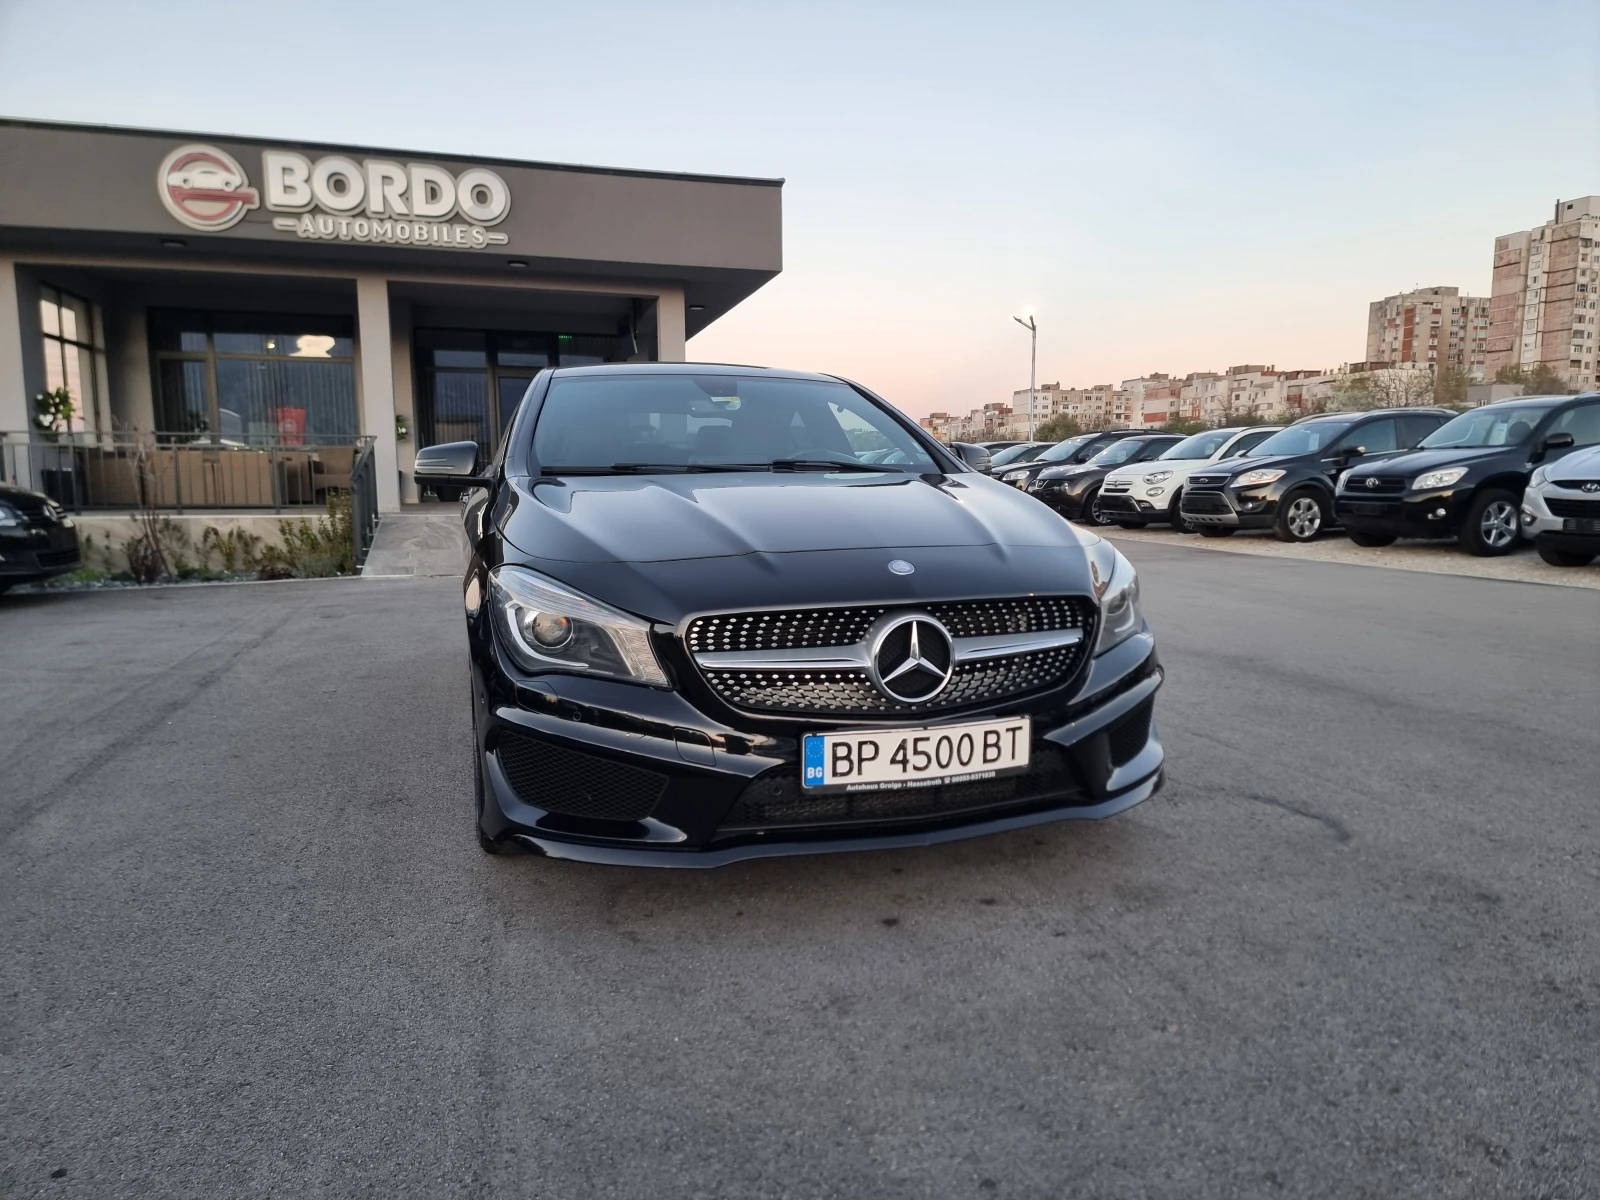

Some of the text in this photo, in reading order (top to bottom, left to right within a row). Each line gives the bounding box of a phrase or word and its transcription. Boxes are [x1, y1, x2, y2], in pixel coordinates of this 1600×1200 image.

[265, 152, 509, 222] BORDO
[299, 220, 485, 246] AUTOMOBILES
[831, 725, 1024, 778] BP 4500 BT
[807, 767, 823, 778] BG
[846, 783, 879, 792] Autohaus
